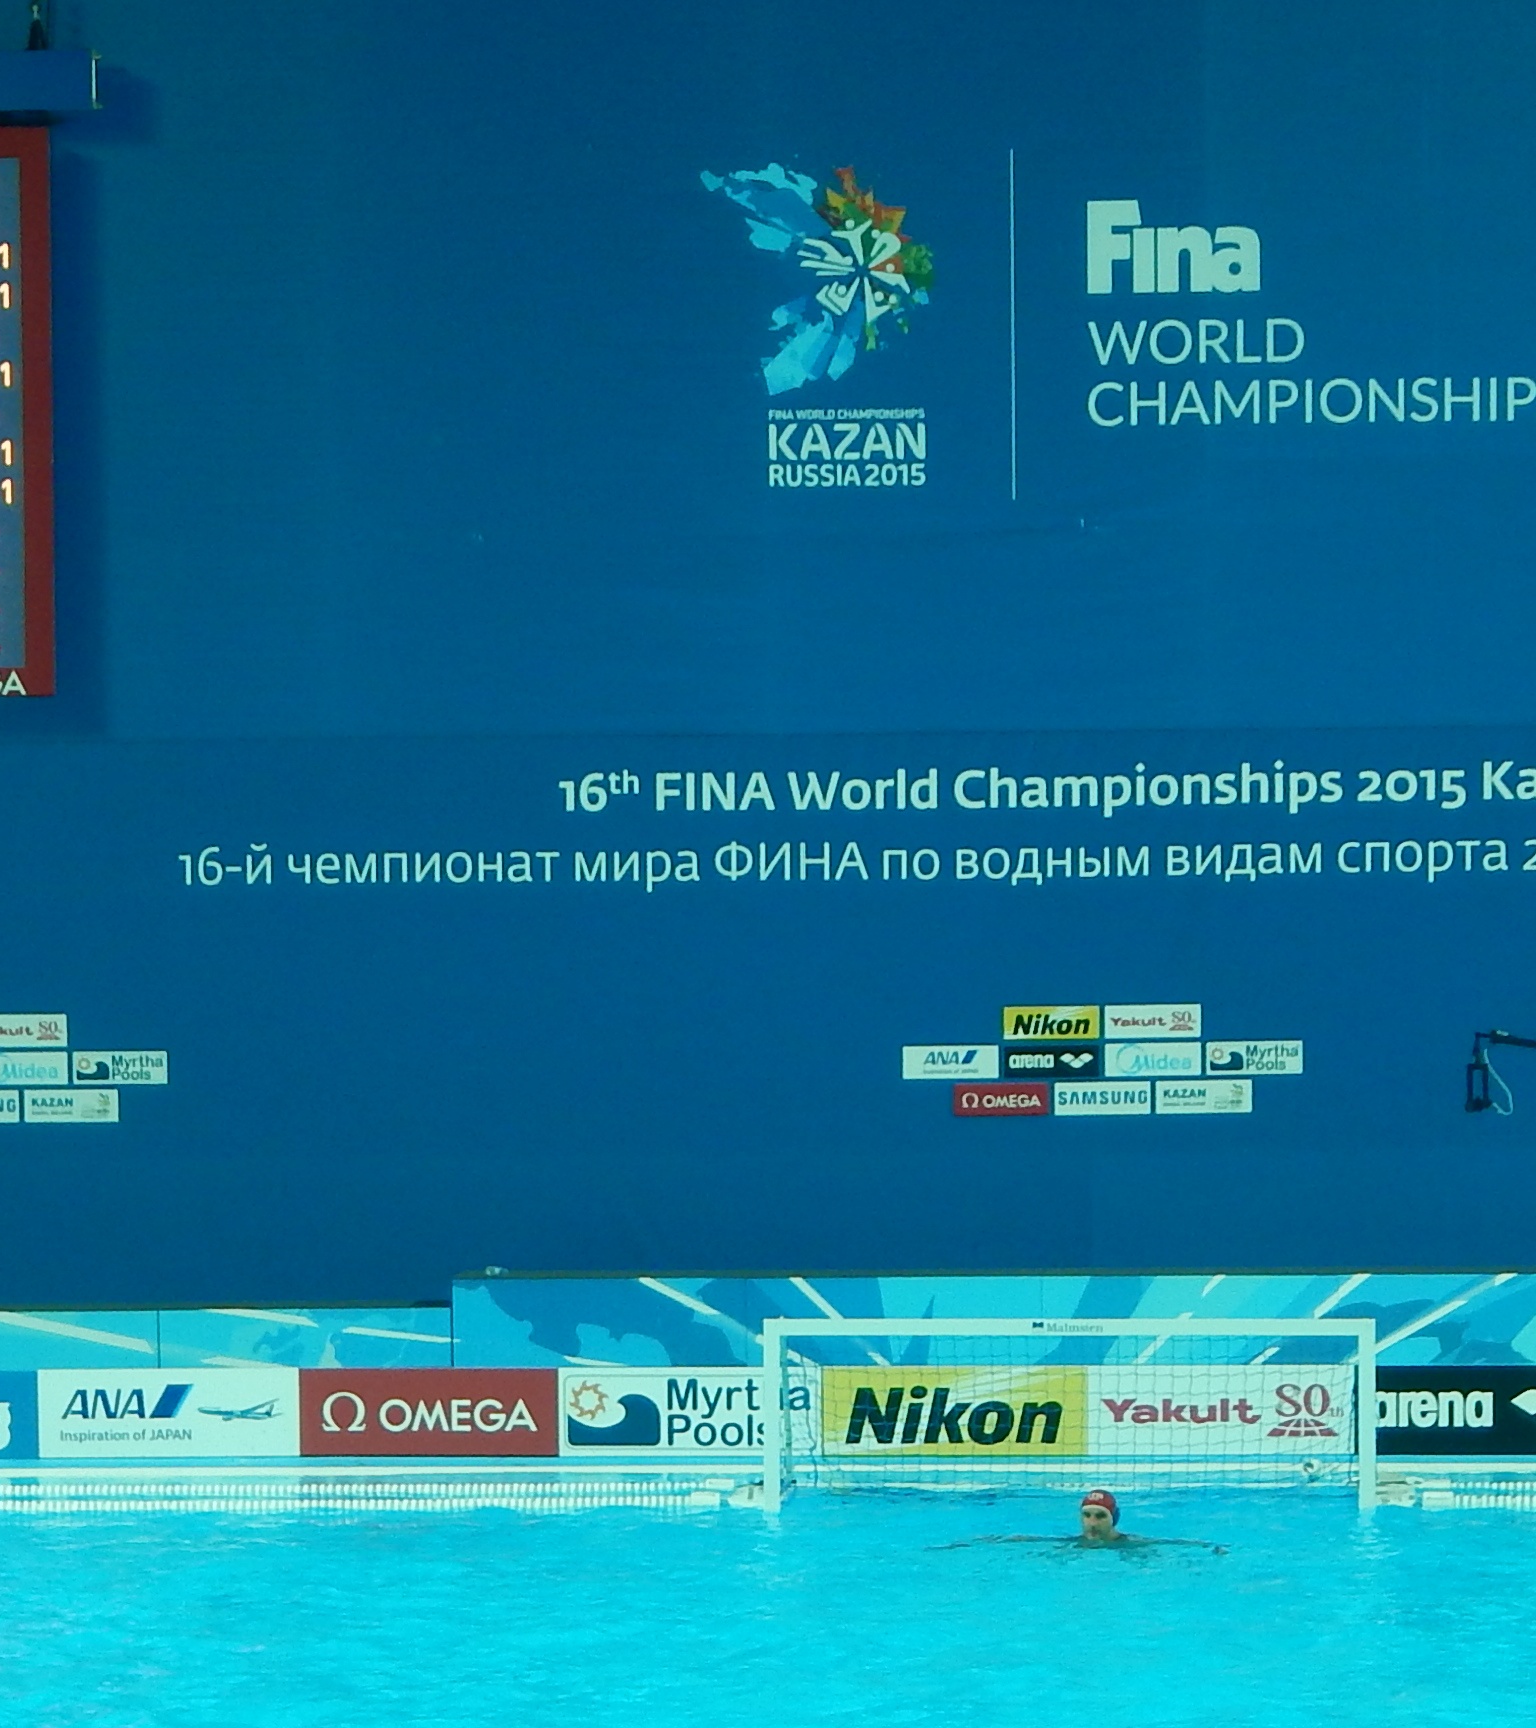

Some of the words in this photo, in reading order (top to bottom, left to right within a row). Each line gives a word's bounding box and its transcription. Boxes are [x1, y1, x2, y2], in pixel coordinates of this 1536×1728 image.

[1086, 199, 1262, 296] Fina
[1087, 318, 1305, 366] WORLD
[768, 409, 793, 421] FINA
[795, 409, 835, 421] WORLD
[837, 408, 926, 420] CHAMPIONSHIPS
[768, 421, 928, 461] KAZAN
[768, 463, 862, 488] RUSSIA
[863, 463, 927, 487] 2015
[559, 768, 641, 813] 16th
[654, 770, 776, 813] FINA
[788, 766, 940, 811] World
[954, 759, 1420, 816] Championships
[1357, 768, 1467, 808] 2015
[178, 842, 273, 886] 16-й
[286, 849, 560, 885] чемпионат
[572, 849, 700, 892] мира
[712, 840, 867, 882] ФИНА
[880, 846, 940, 880] по
[954, 837, 1153, 888] водным
[1166, 843, 1324, 882] видам
[1336, 838, 1510, 882] спорта
[1013, 1014, 1090, 1035] Nikon
[1110, 1016, 1167, 1027] Yakult
[923, 1050, 960, 1065] ANA
[1246, 1045, 1298, 1058] Myrtha
[112, 1055, 163, 1070] Myrtha
[1009, 1054, 1055, 1069] arena
[1246, 1058, 1286, 1070] Pools
[112, 1068, 151, 1080] Pools
[1058, 1091, 1148, 1105] SAMSUNG
[1163, 1088, 1206, 1098] KAZAN
[31, 1097, 74, 1107] KAZAN
[982, 1094, 1041, 1108] OMEGA
[1046, 1322, 1104, 1332] Malmsten
[61, 1387, 147, 1420] ANA
[1100, 1397, 1263, 1424] Yakult
[1375, 1389, 1494, 1428] arena
[378, 1398, 539, 1433] OMEGA
[844, 1386, 1063, 1445] Nikon
[59, 1429, 128, 1444] Inspiration
[131, 1429, 147, 1442] of
[149, 1428, 193, 1442] JAPAN
